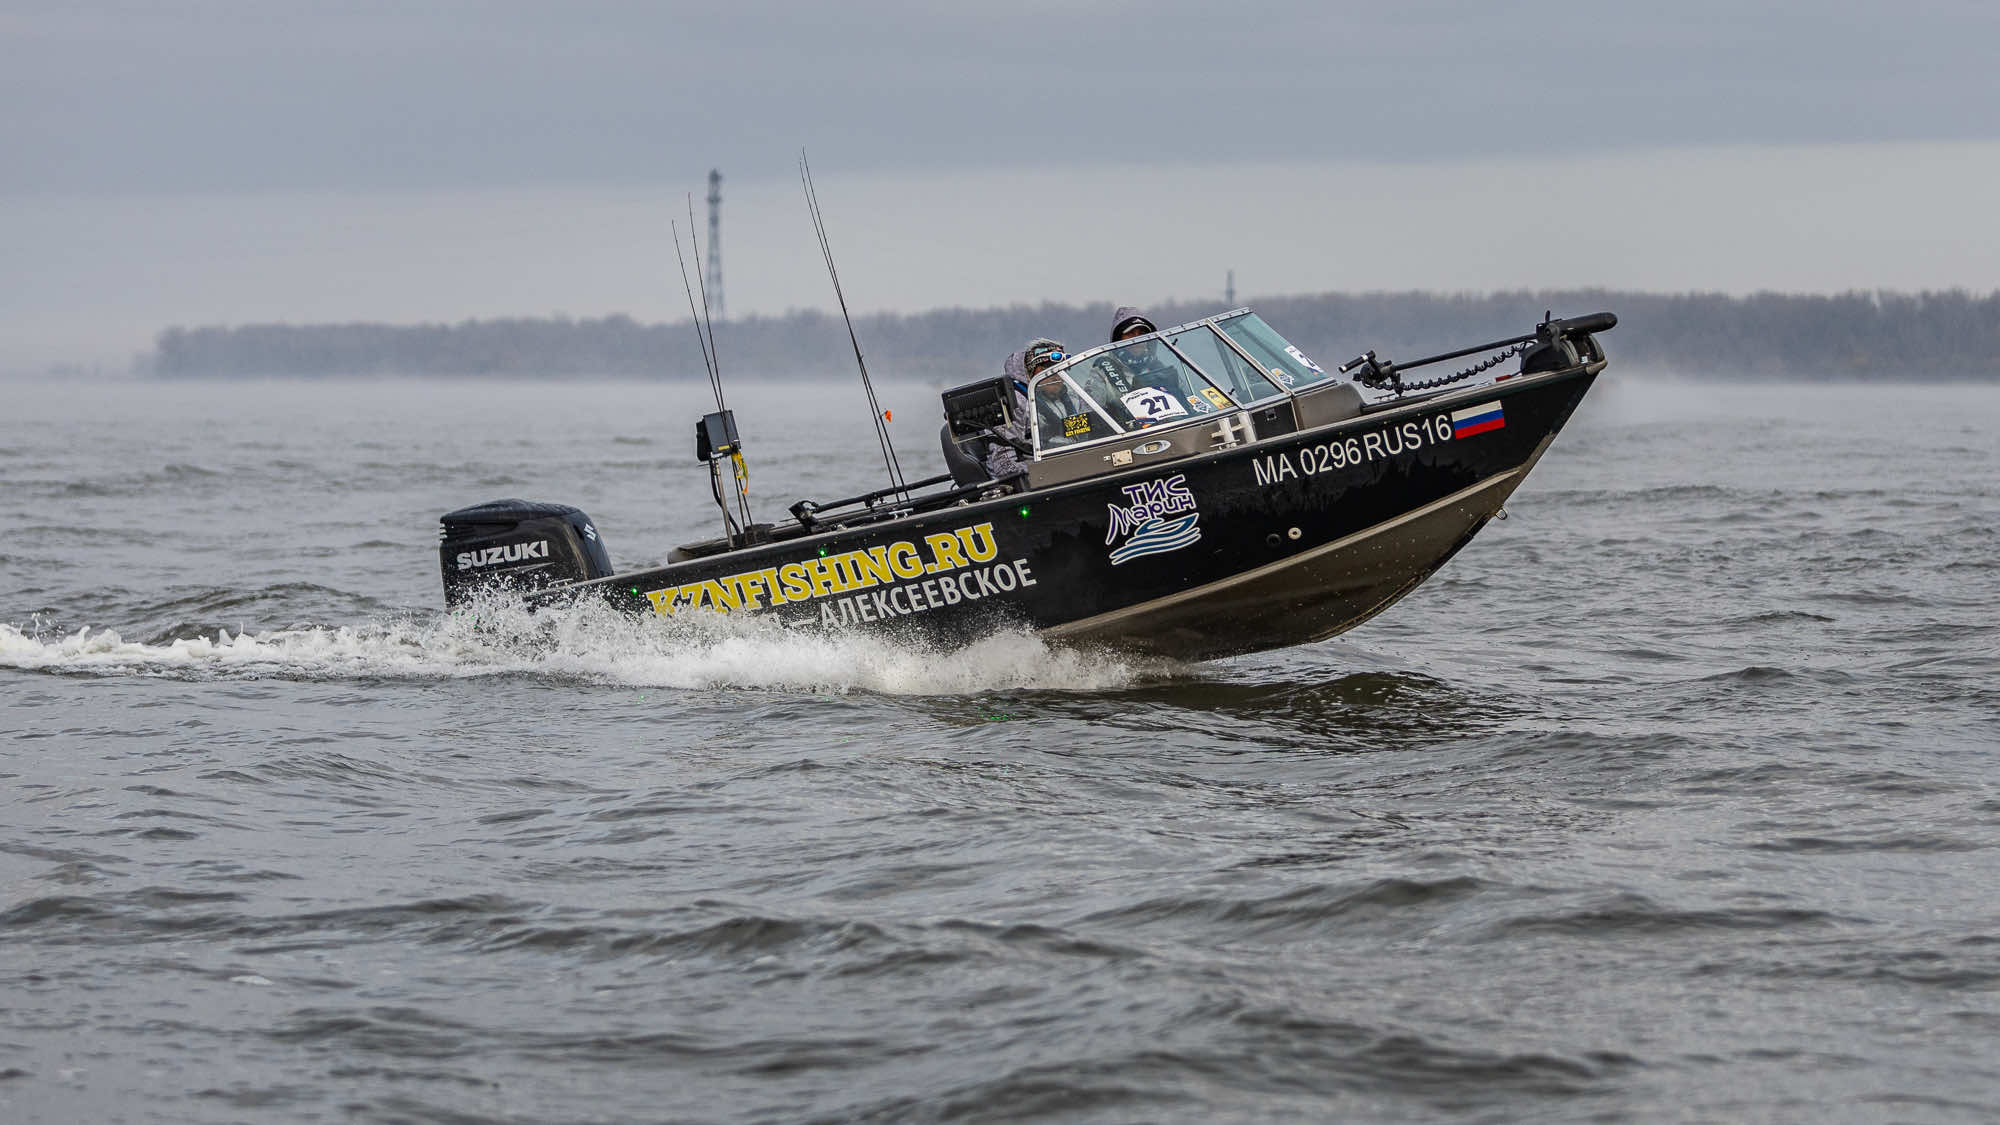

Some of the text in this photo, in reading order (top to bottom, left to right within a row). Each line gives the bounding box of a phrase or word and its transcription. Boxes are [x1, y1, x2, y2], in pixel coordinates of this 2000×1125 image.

[1140, 395, 1171, 416] 27
[1252, 413, 1453, 487] MA 0296 RUS16
[1121, 474, 1190, 506] ТИС
[456, 540, 550, 570] SUZUKI
